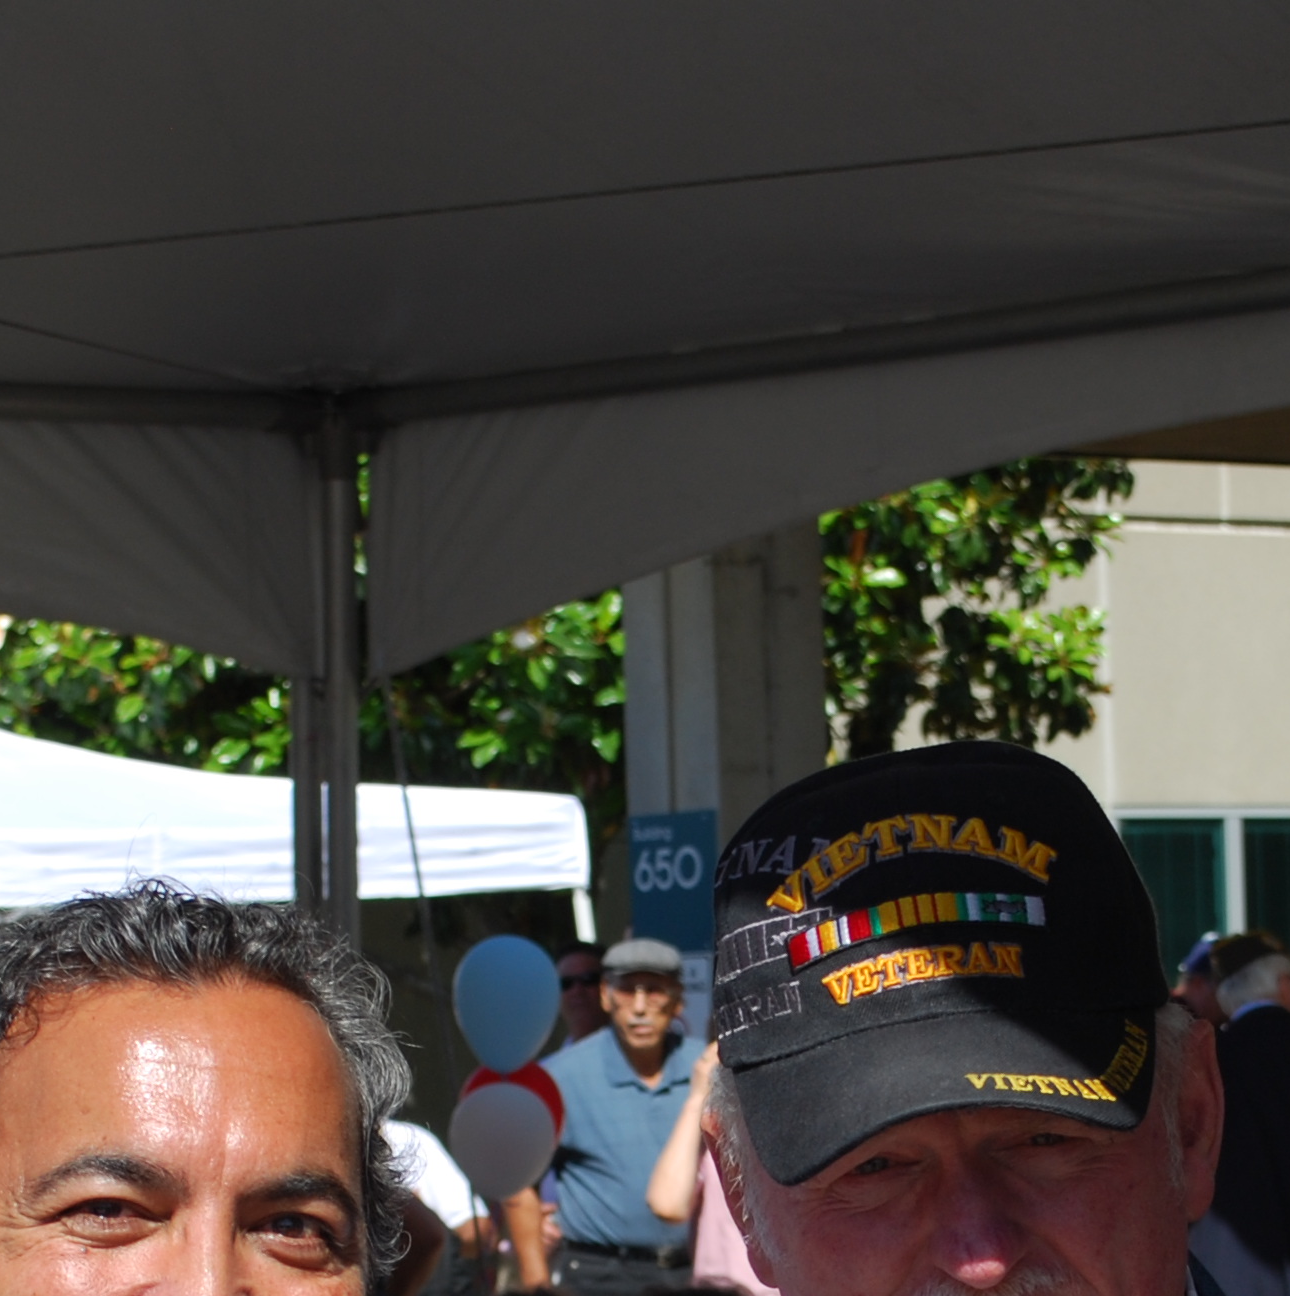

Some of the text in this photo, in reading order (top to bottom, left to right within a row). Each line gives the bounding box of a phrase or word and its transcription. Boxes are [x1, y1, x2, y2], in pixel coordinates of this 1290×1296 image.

[634, 844, 704, 893] 650
[766, 812, 1058, 914] VIETNAM
[821, 942, 1025, 1006] VETERAN
[965, 1072, 1117, 1102] VIETNAM
[1100, 1018, 1149, 1094] VETERAN
